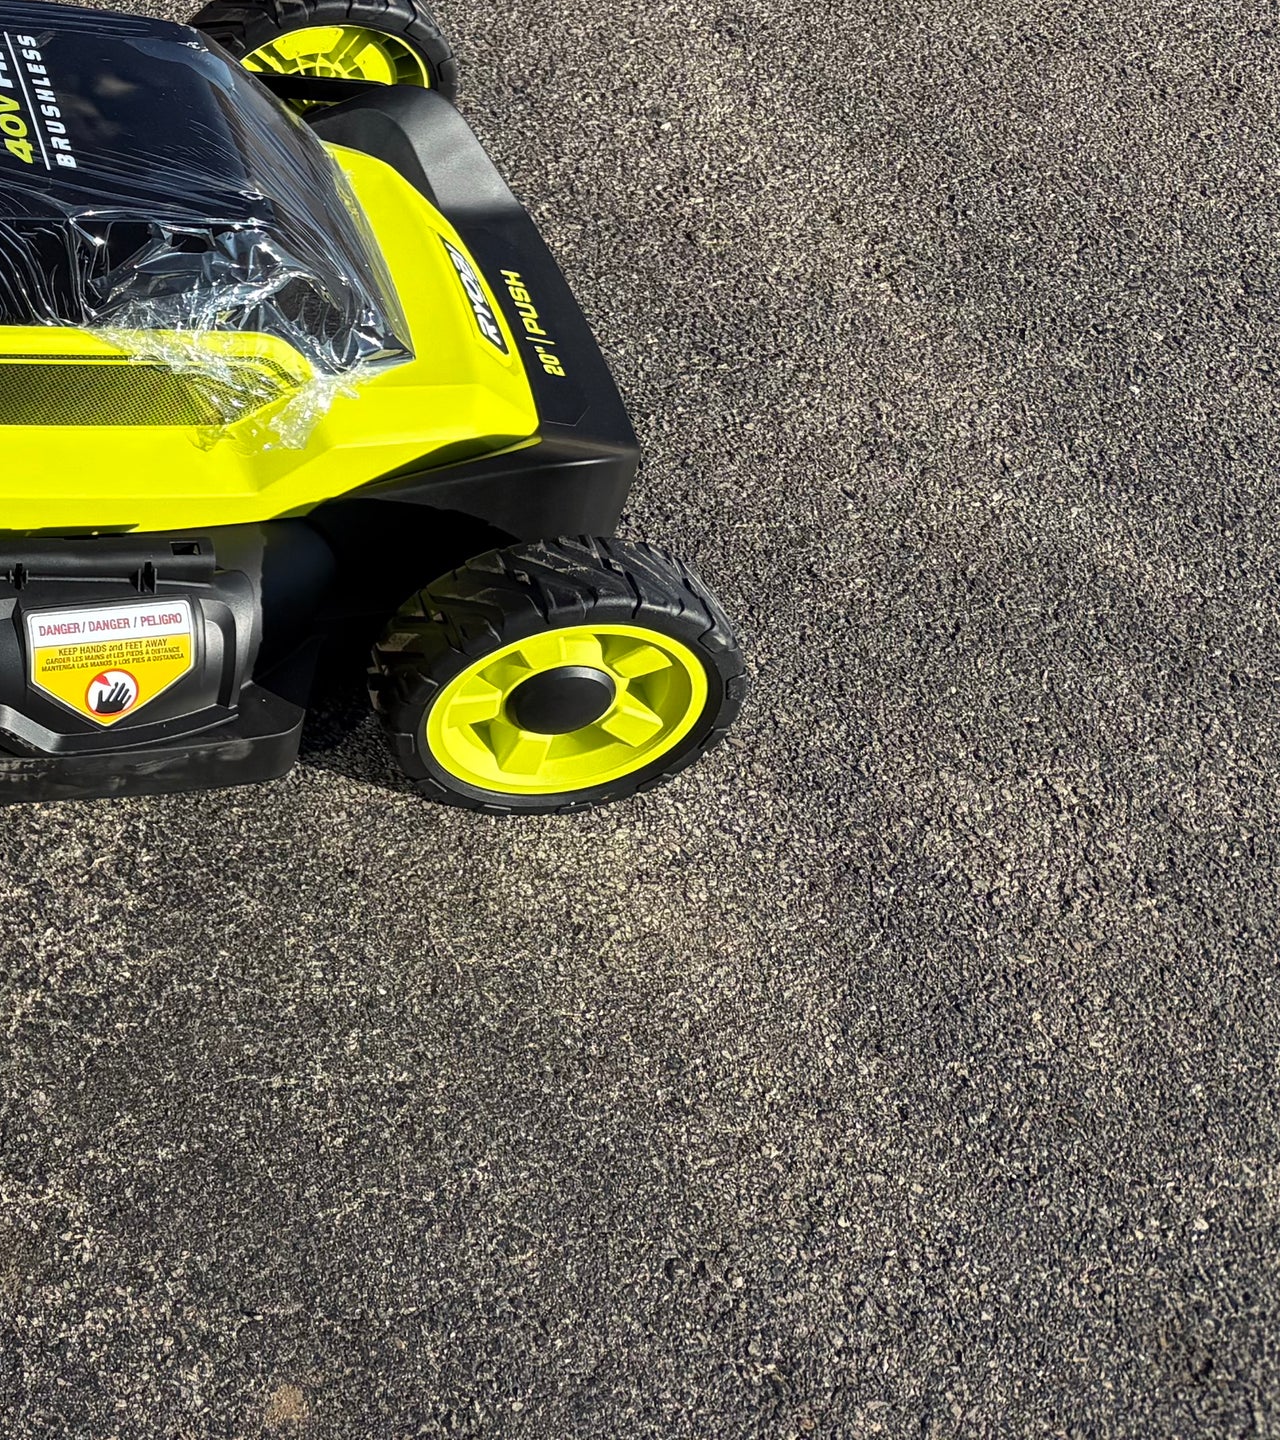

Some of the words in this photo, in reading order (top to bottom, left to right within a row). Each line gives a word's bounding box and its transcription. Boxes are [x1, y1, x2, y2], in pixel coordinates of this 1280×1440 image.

[17, 35, 77, 168] BRUSHLESS
[444, 241, 502, 346] RYOBI
[500, 269, 547, 335] PUSH
[39, 622, 80, 637] DANGER
[88, 618, 130, 632] DANGER
[141, 613, 182, 627] PELIGRO
[58, 647, 78, 656] KEEP
[80, 645, 107, 654] HANDS
[109, 643, 123, 651] and
[125, 641, 143, 649] FEET
[145, 638, 167, 648] AWAY
[77, 662, 89, 670] LAS
